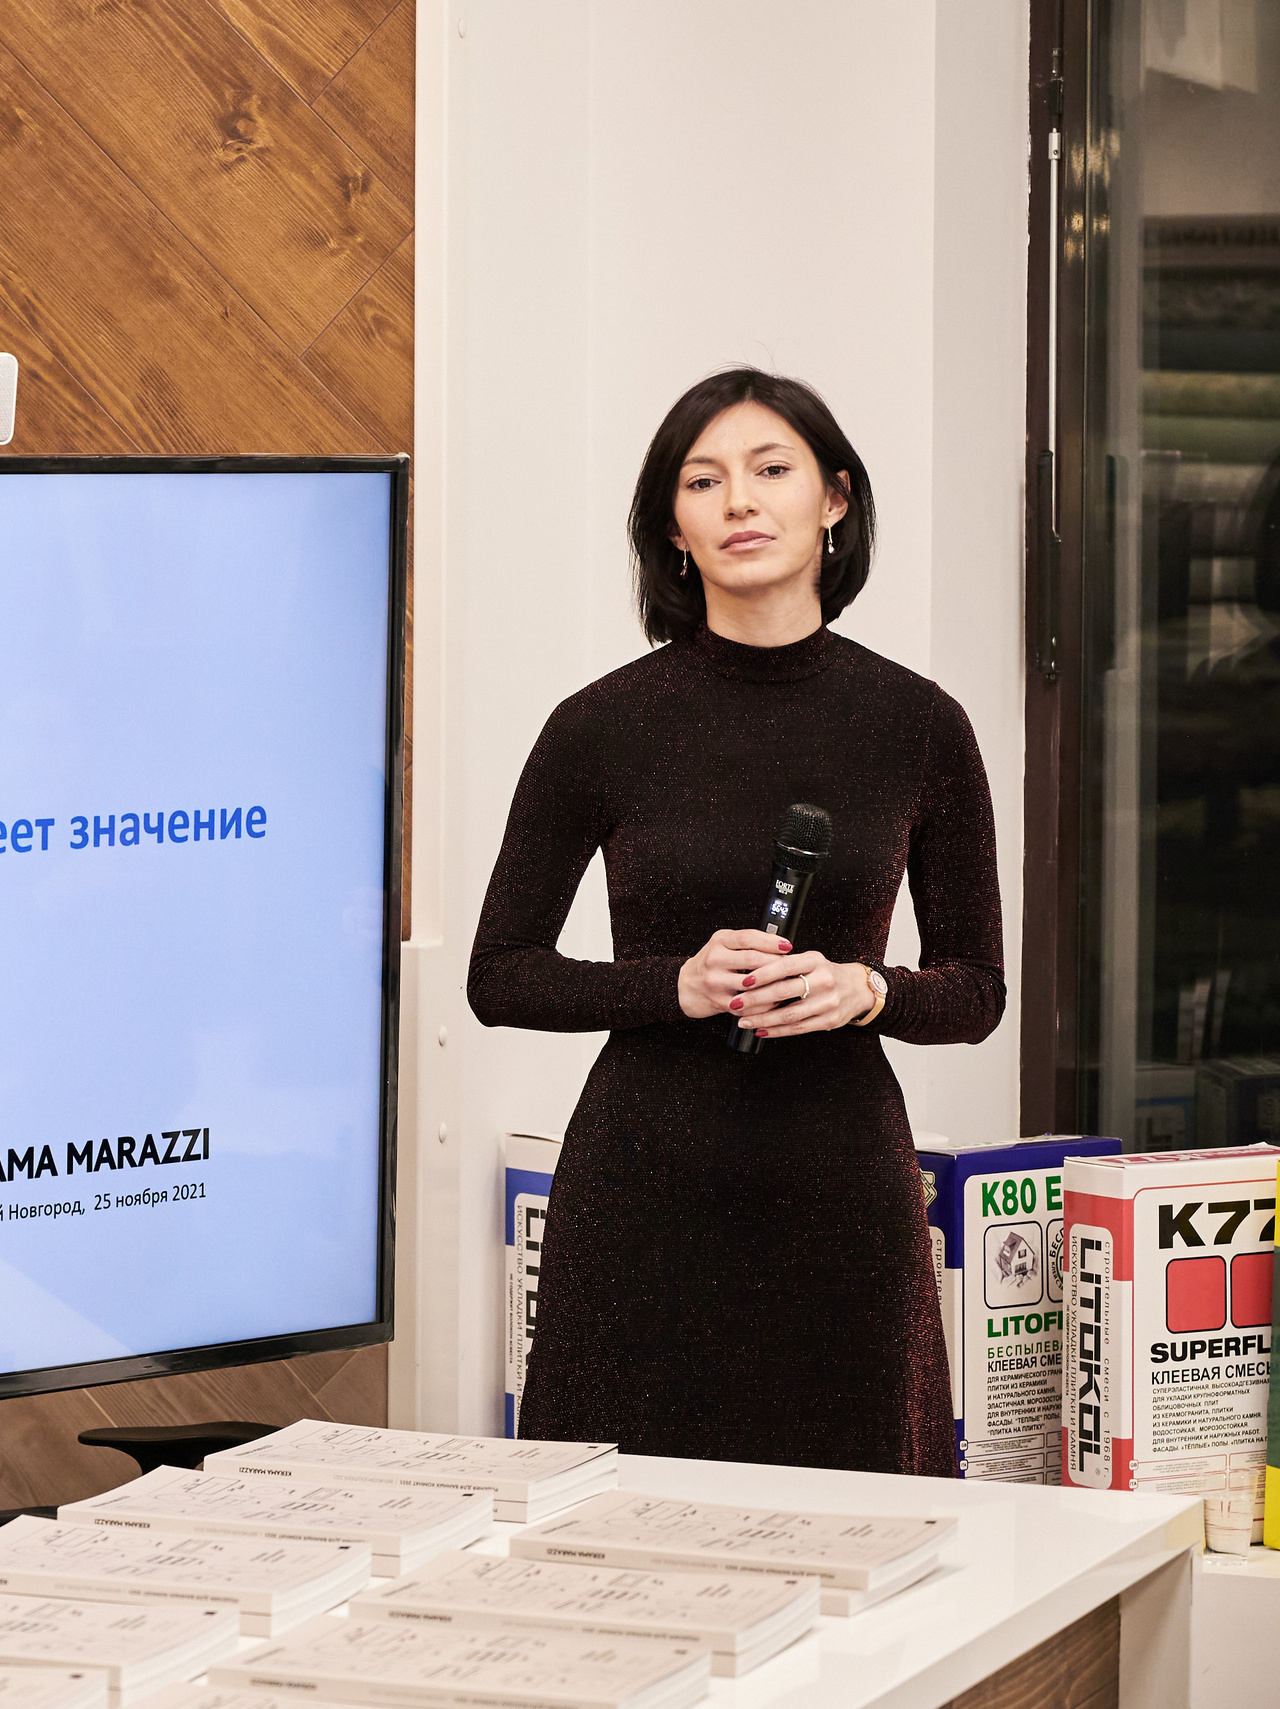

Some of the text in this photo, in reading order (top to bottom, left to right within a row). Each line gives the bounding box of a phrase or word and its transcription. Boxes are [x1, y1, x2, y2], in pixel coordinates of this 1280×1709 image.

[69, 804, 268, 850] значение
[66, 1128, 210, 1175] MARAZZI
[8, 1198, 85, 1221] Новгород,
[94, 1194, 111, 1211] 25
[115, 1187, 168, 1210] ноября
[172, 1182, 206, 1202] 2021
[981, 1175, 1063, 1218] K80 E
[1079, 1237, 1102, 1472] LITOKOL
[988, 1356, 1037, 1373] КЛЕЕВАЯ
[987, 1376, 999, 1384] ДЛЯ
[1000, 1370, 1047, 1381] КЕРАМИЧЕСКОГО
[1151, 1366, 1221, 1385] КЛЕЕВАЯ
[988, 1384, 1009, 1392] ПЛИТКИ
[1019, 1379, 1048, 1388] КЕРАМИКИ
[993, 1389, 1036, 1400] НАТУРАЛЬНОГО
[1152, 1396, 1164, 1404] ДЛЯ
[1193, 1388, 1250, 1398] КРУПНОФОРМАТНЫХ
[1001, 1407, 1036, 1417] ВНУТРЕННИХ
[1152, 1401, 1201, 1411] ОБЛИЦОВОЧНЫХ
[1070, 1417, 1076, 1426] И
[1198, 1414, 1241, 1423] НАТУРАЛЬНОГО
[1166, 1435, 1203, 1443] ВНУТРЕННИХ
[1210, 1431, 1240, 1439] НАРУЖНЫХ
[239, 1467, 292, 1477] KERAMA MARAZZI
